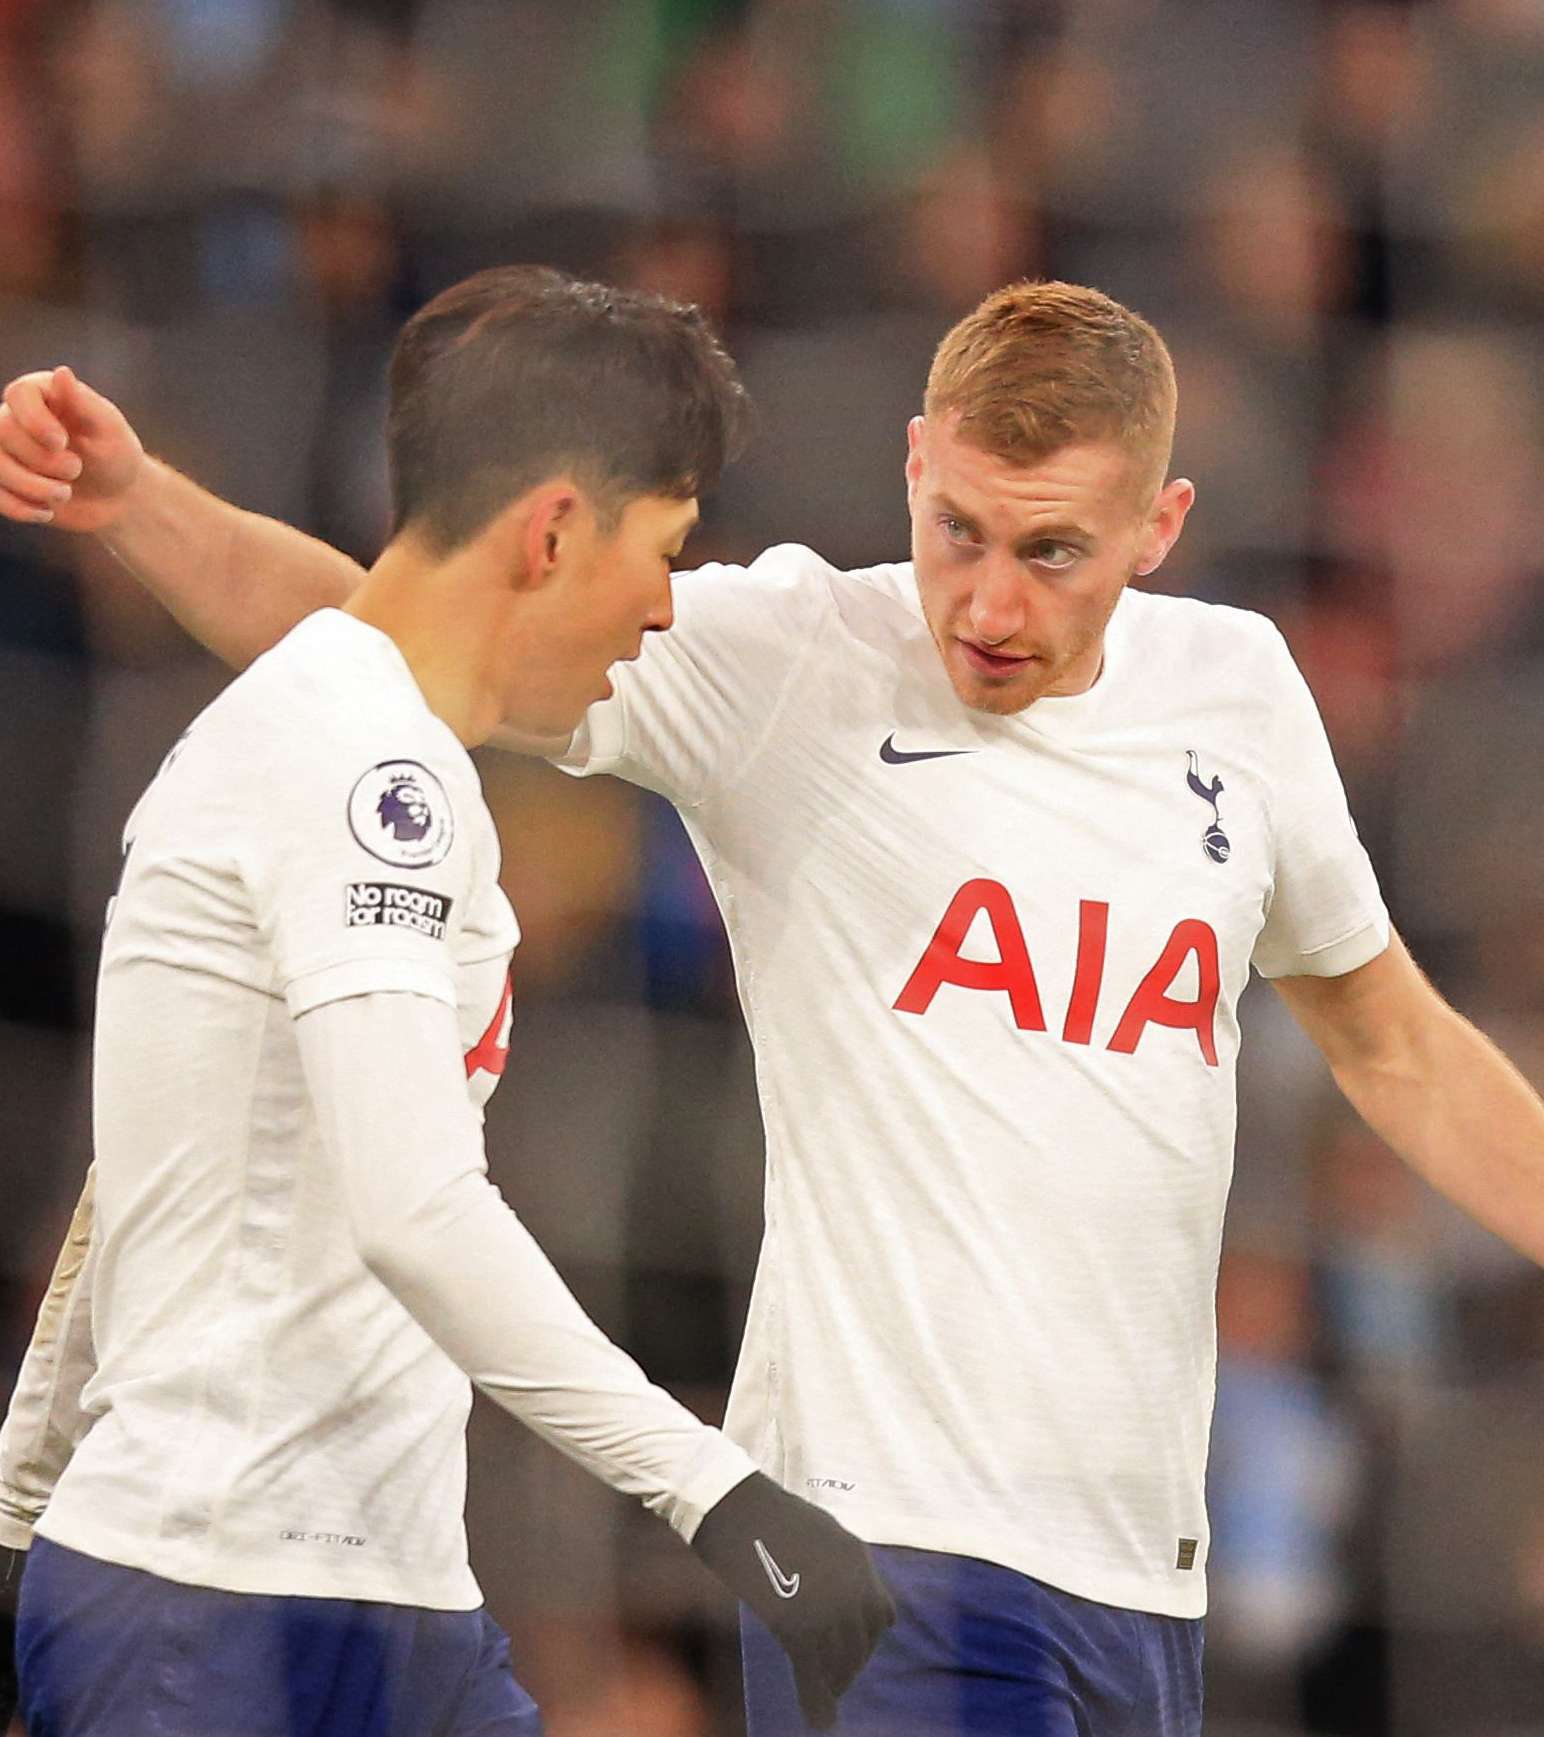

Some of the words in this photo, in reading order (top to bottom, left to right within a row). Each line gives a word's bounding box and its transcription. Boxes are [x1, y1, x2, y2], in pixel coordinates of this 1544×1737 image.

[346, 884, 382, 906] No
[383, 887, 443, 919] room
[892, 878, 1221, 1067] AIA
